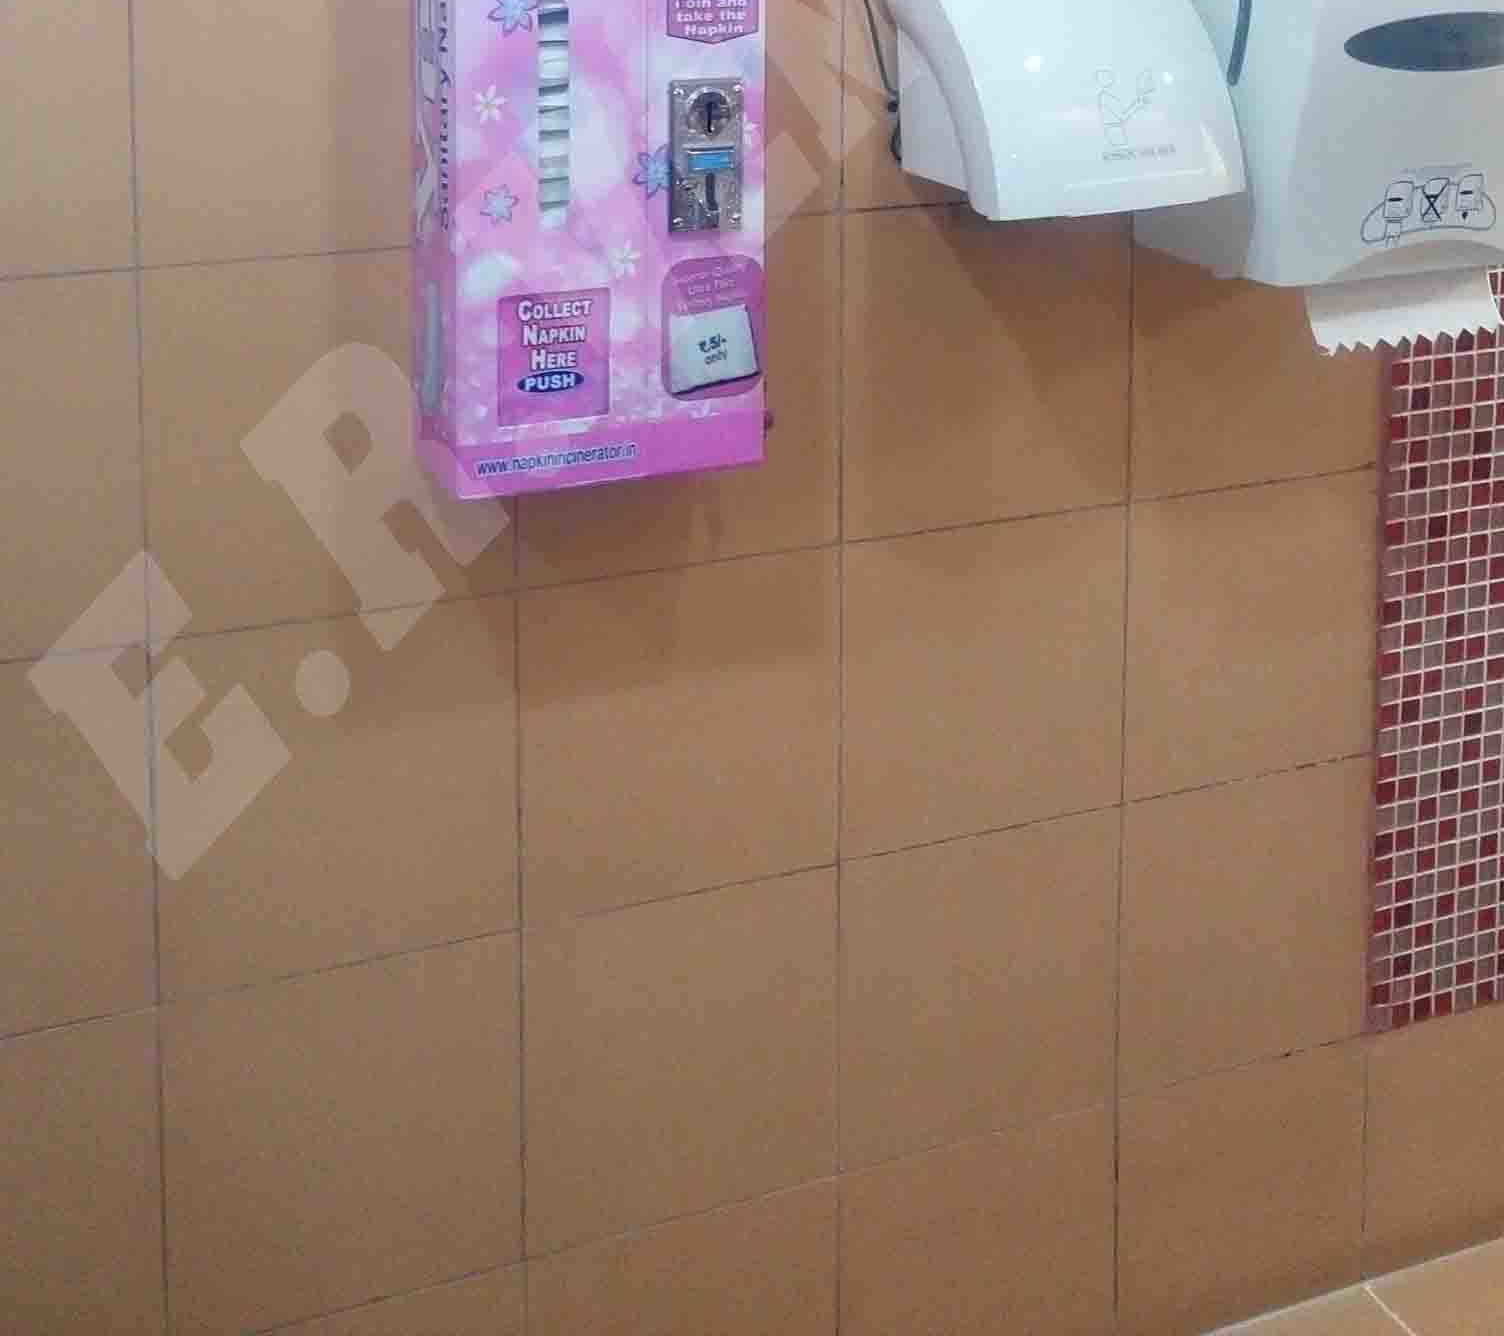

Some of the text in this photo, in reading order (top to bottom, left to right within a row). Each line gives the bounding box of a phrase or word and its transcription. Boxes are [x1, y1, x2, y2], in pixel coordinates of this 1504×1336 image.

[677, 8, 745, 23] take the
[684, 23, 744, 38] Napkin
[517, 299, 593, 322] COLLECT
[522, 324, 586, 347] NAPKIN
[531, 349, 577, 370] HERE
[524, 373, 575, 391] PUSH
